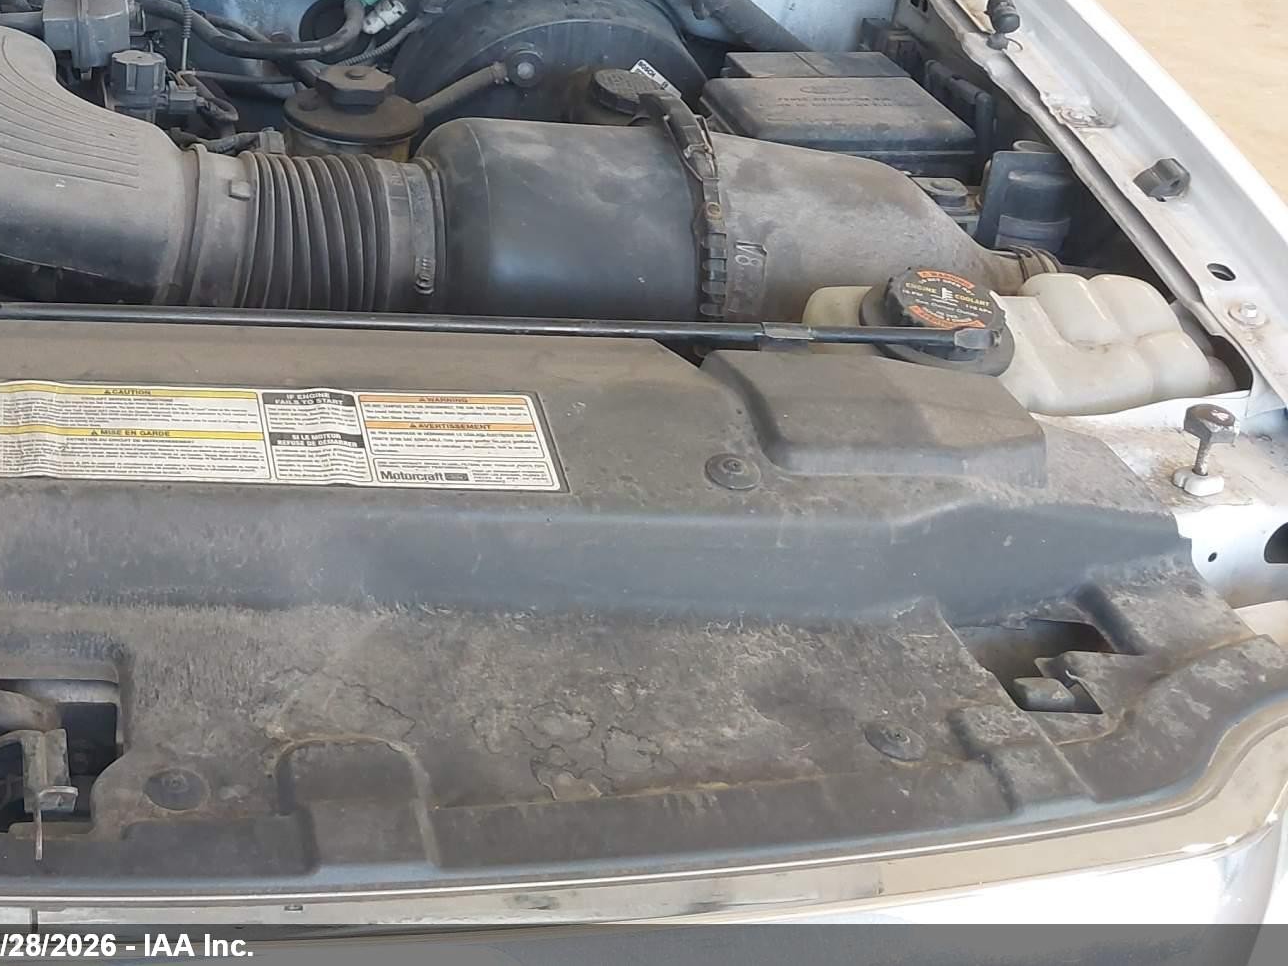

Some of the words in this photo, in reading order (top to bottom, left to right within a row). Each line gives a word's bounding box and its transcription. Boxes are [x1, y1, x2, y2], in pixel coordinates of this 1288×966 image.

[905, 282, 937, 294] ENGINE
[954, 294, 990, 307] COOLANT
[296, 392, 330, 400] ENGINE
[379, 470, 444, 482] Motorcraft
